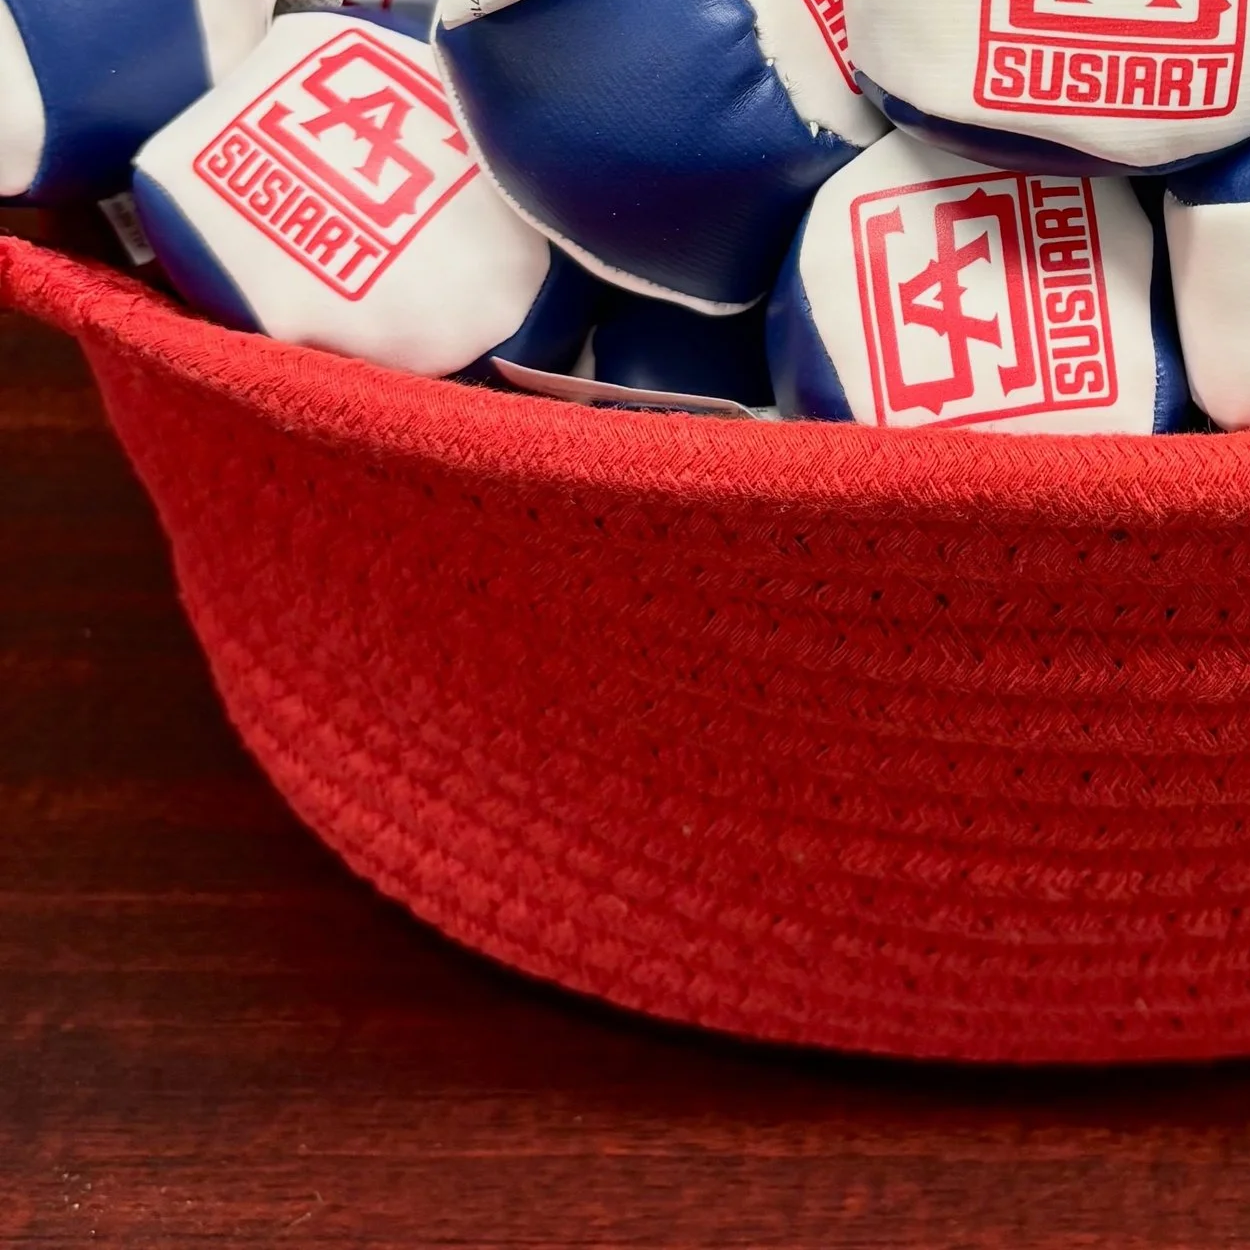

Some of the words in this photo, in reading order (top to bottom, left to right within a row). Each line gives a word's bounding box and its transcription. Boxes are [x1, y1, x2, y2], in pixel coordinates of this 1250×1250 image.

[989, 45, 1229, 107] SUSIART
[207, 133, 382, 281] SUSIART
[1030, 179, 1105, 395] SUSIART
